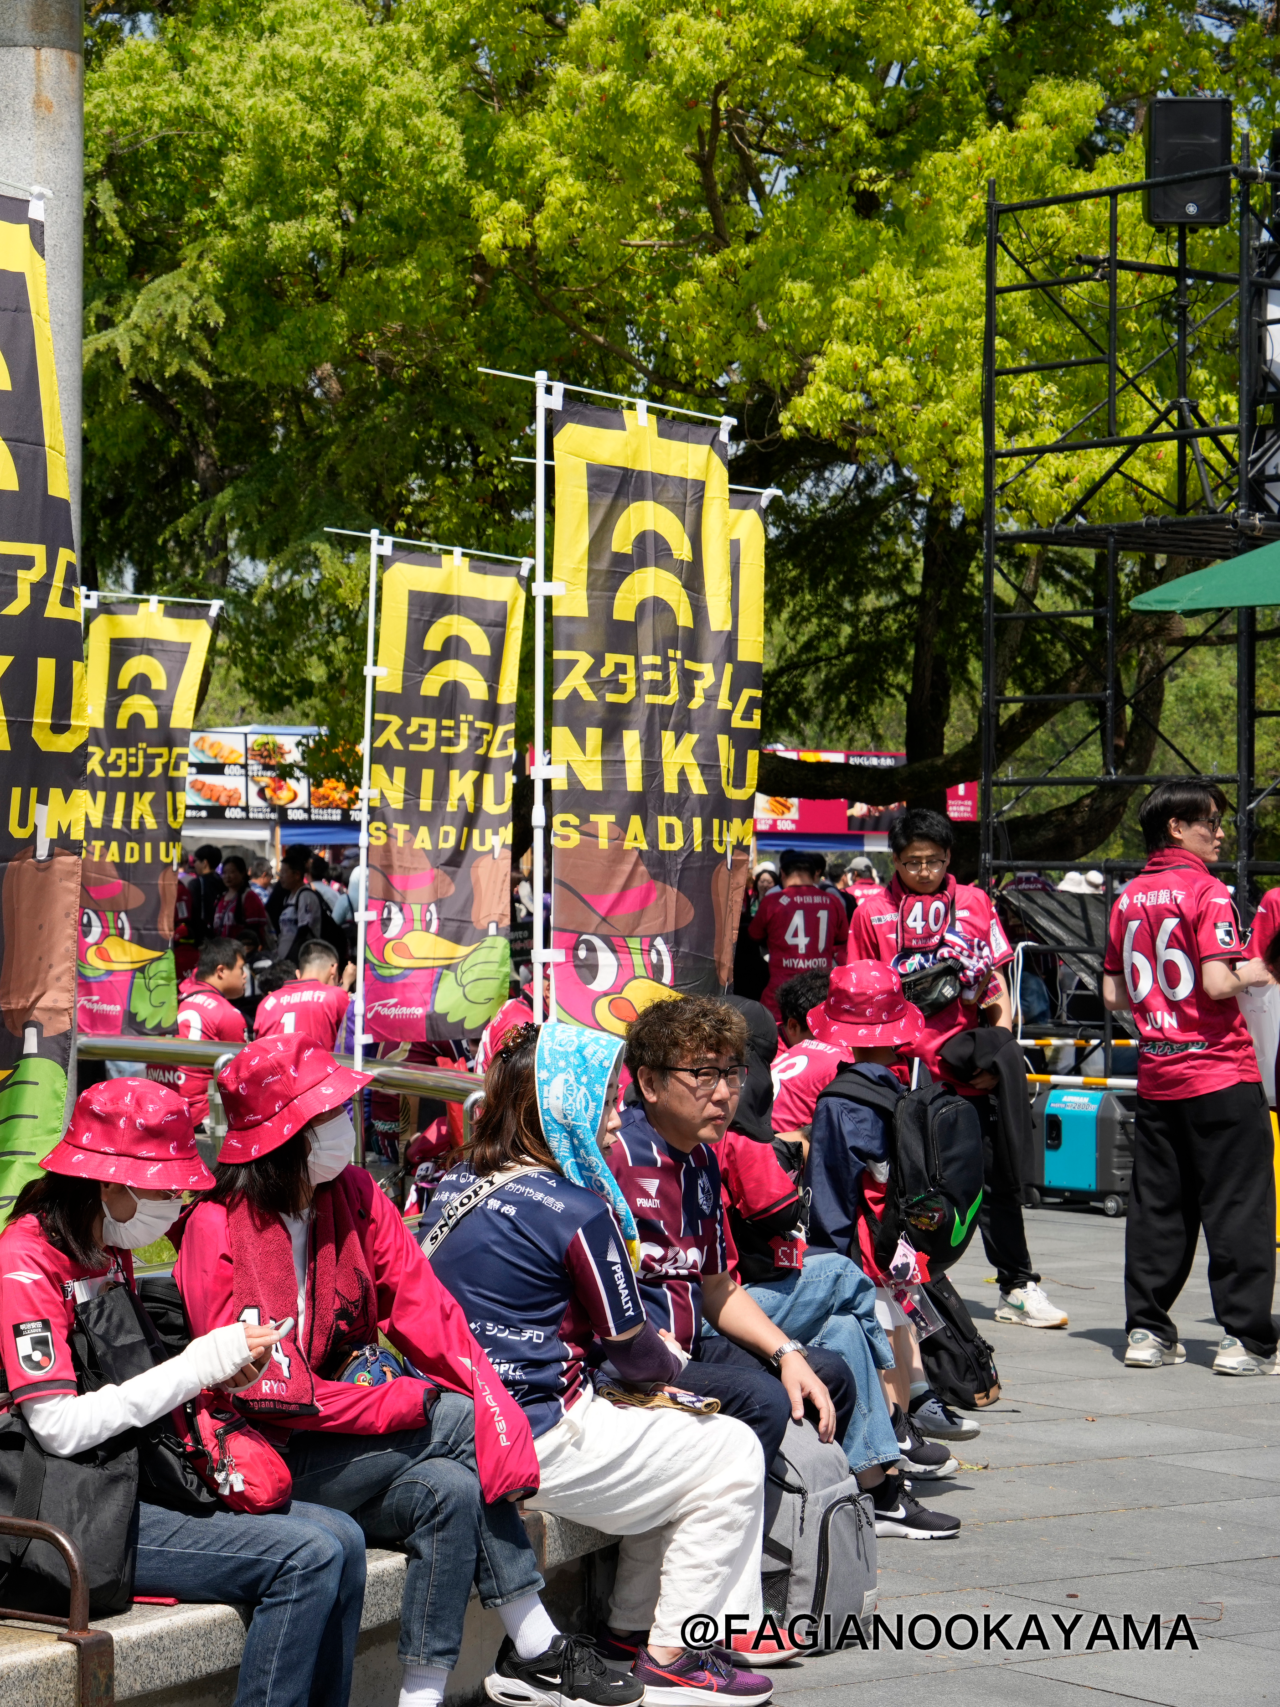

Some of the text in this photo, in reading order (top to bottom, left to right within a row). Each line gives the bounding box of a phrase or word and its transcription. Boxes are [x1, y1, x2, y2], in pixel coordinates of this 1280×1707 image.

[369, 764, 513, 816] NIKU
[84, 791, 186, 830] NIKU
[368, 821, 513, 852] STADIUM
[553, 813, 732, 855] STADIU
[1133, 889, 1186, 908] 中国銀行
[784, 909, 829, 954] 41
[906, 900, 946, 935] 40
[782, 957, 827, 968] MIYAMOTO
[1122, 917, 1195, 1004] 66
[280, 990, 326, 1006] 中国銀行
[366, 998, 423, 1019] Fagiano
[1145, 1011, 1178, 1030] JUN
[147, 1069, 186, 1085] AWANO
[429, 1174, 497, 1246] SNOOPY
[504, 1181, 566, 1213] おかやま信金
[635, 1197, 660, 1209] PENALTY
[611, 1264, 635, 1317] PENALTY
[486, 1322, 544, 1344] シンニチロ
[262, 1380, 286, 1395] RYO
[472, 1365, 511, 1447] PENALTY
